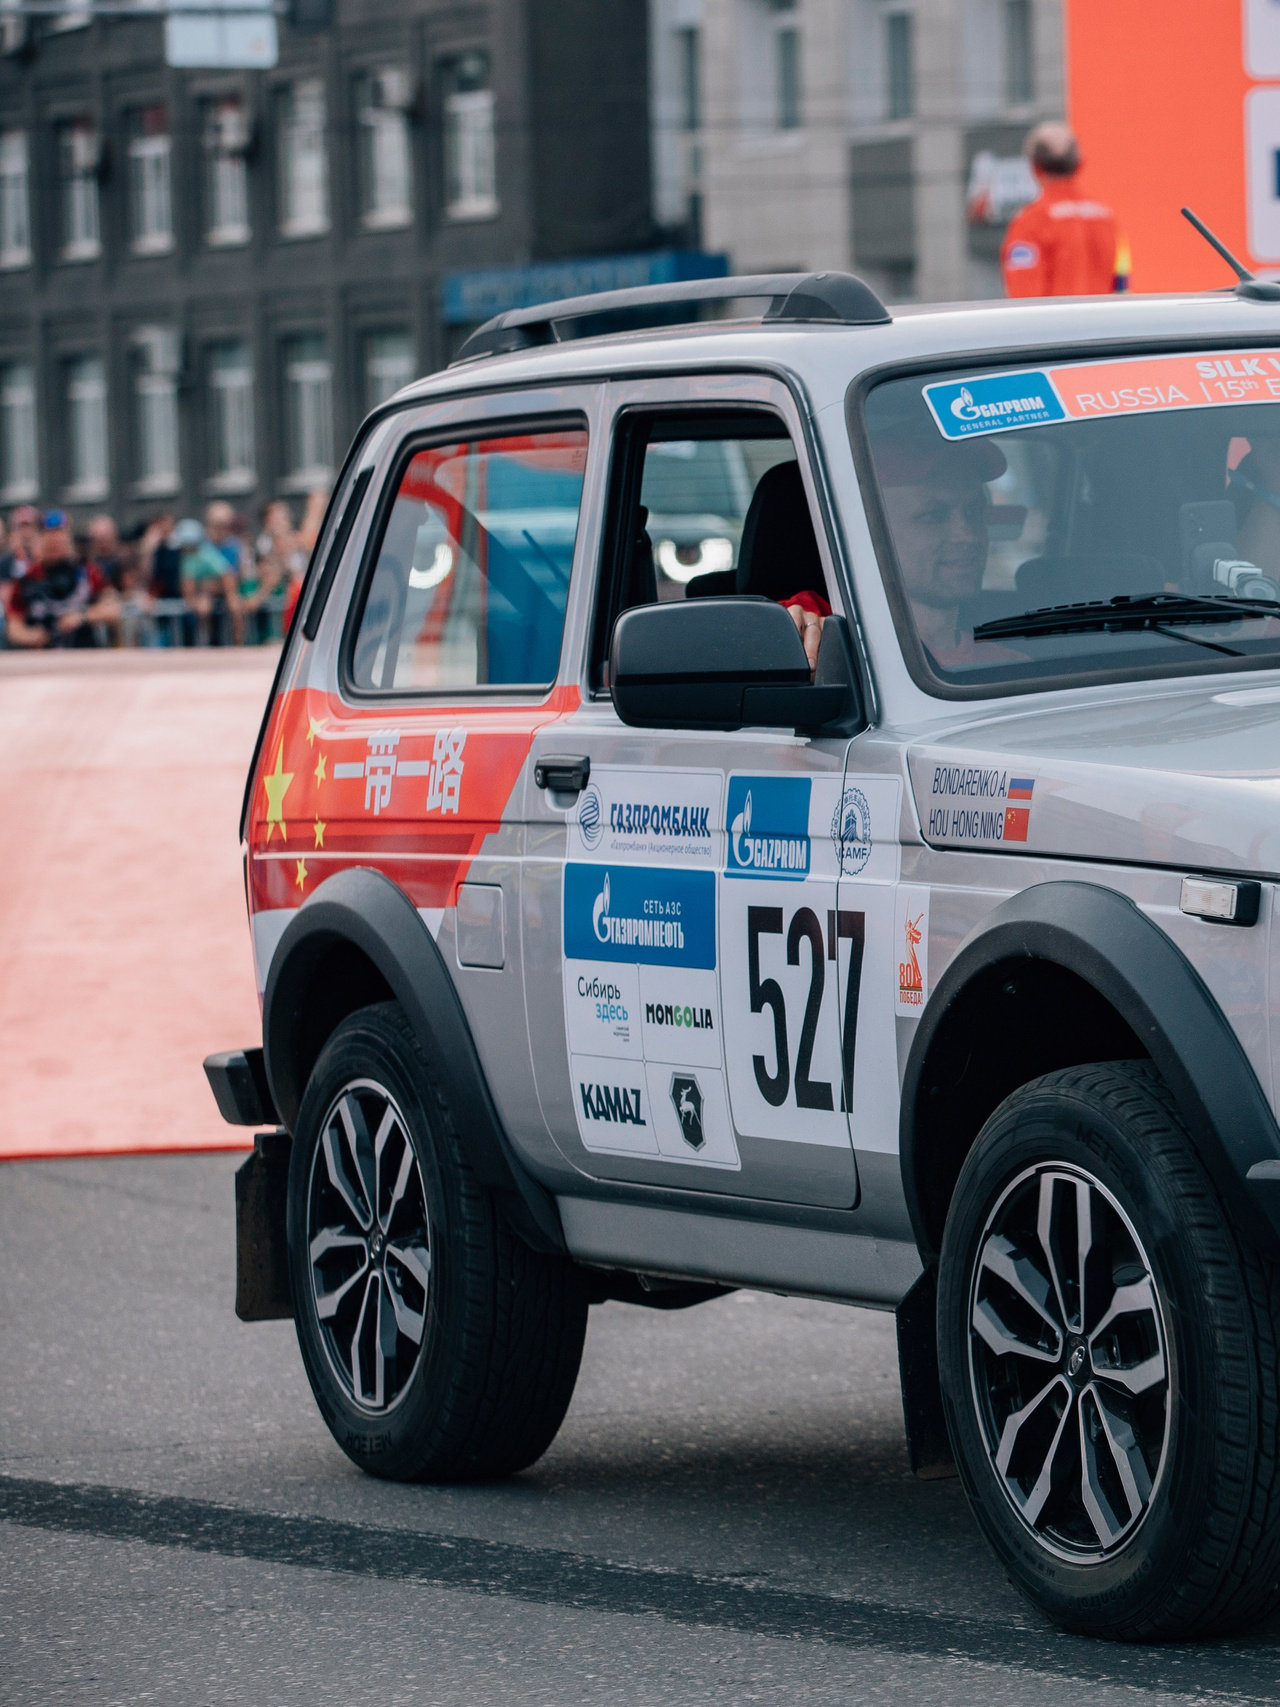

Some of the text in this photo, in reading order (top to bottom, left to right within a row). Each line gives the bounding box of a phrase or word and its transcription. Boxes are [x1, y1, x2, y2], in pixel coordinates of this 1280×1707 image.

[1195, 357, 1267, 379] SILK
[979, 396, 1046, 418] GAZPROM
[1075, 385, 1190, 413] RUSSIA
[1214, 378, 1260, 400] 15th
[959, 411, 1050, 433] GENERAL PARTNER
[333, 725, 468, 816] 一带一路
[932, 767, 1000, 798] BONDARENKO
[610, 803, 712, 838] ГАЗПРОМБАНК
[928, 808, 1004, 840] HOU HONG NING
[753, 838, 807, 870] GAZPROM
[643, 900, 682, 916] СЕТЬ АЗС
[609, 916, 685, 949] ГАЗПРОМНЕФТЬ
[899, 962, 912, 987] 80
[577, 976, 621, 1005] Сибирь
[595, 1003, 629, 1023] здесь
[645, 1003, 714, 1030] MONGOLIA
[747, 905, 866, 1114] 527
[579, 1082, 647, 1126] KAMAZ
